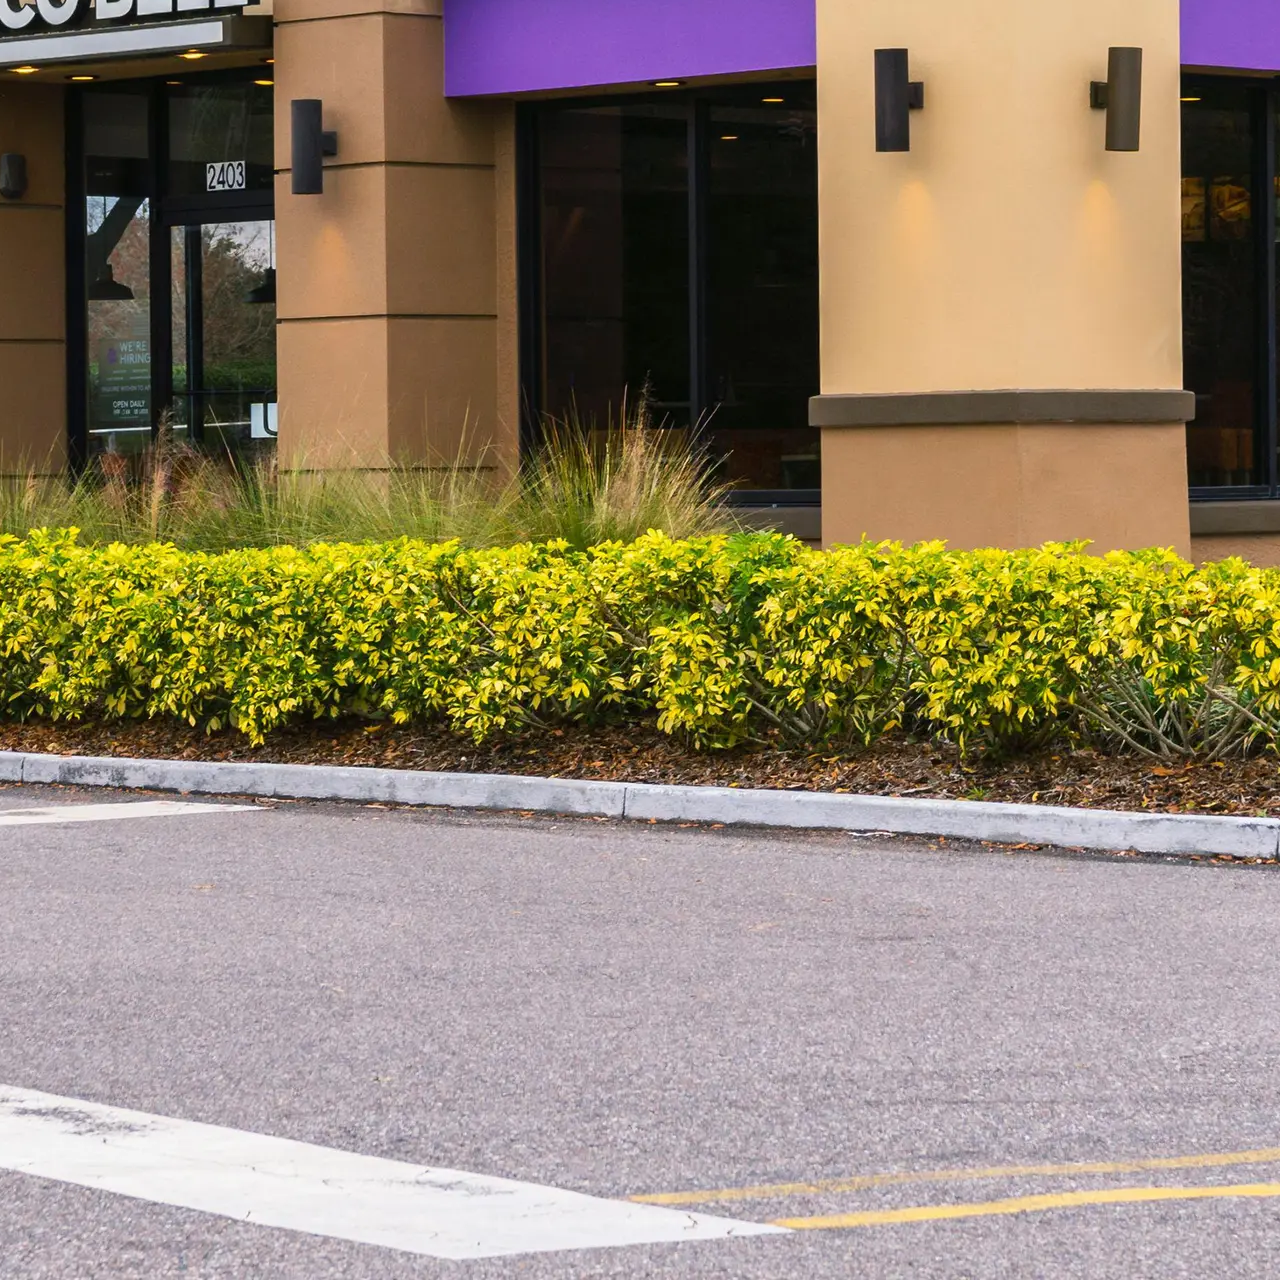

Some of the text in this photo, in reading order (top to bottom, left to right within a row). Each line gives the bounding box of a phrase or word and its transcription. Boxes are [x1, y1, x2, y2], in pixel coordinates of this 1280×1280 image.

[207, 162, 245, 191] 2403
[120, 340, 147, 352] WE'RE
[120, 352, 151, 365] HIRING
[130, 400, 145, 408] DAILY
